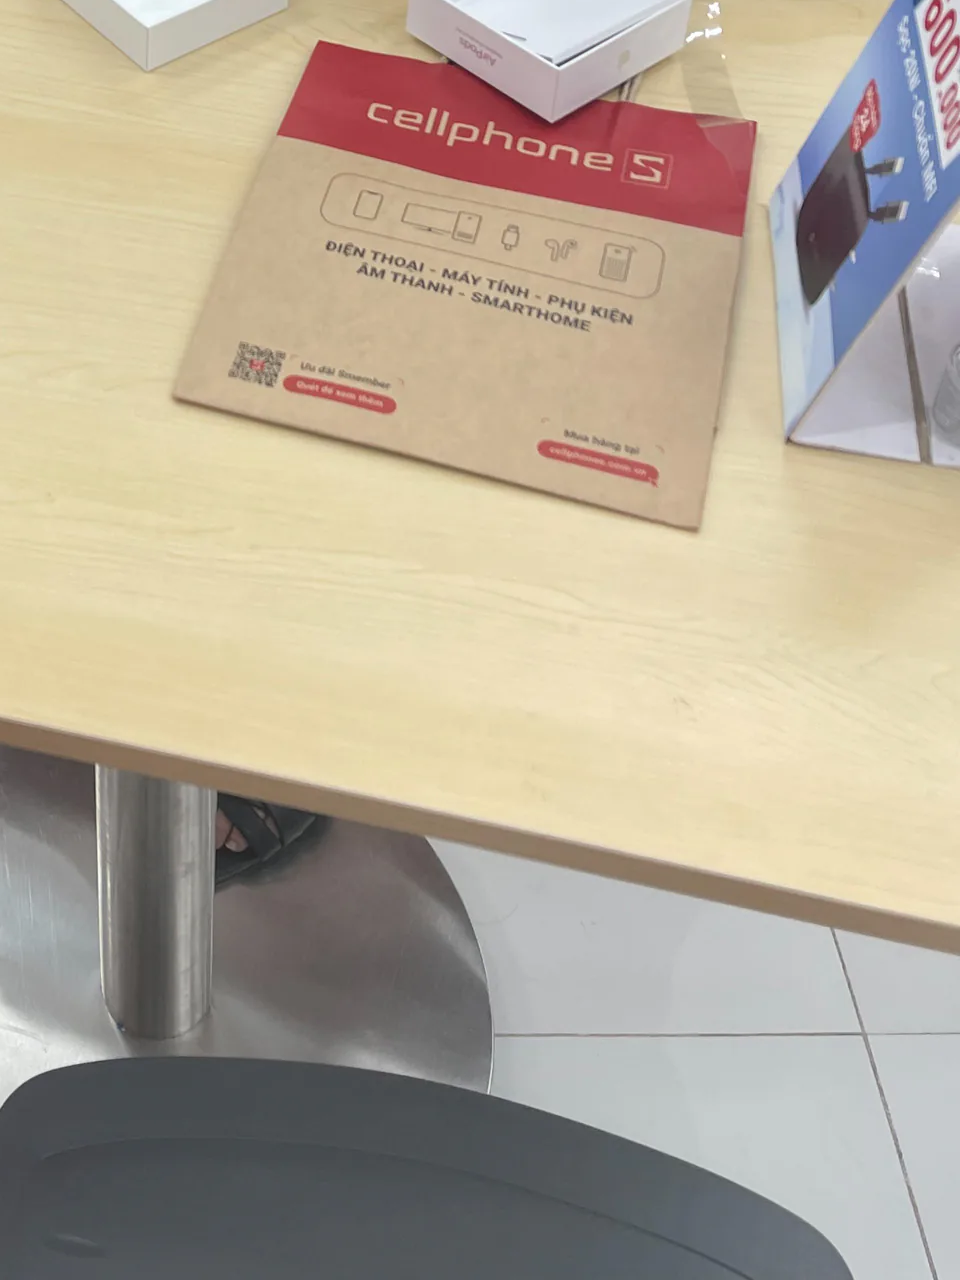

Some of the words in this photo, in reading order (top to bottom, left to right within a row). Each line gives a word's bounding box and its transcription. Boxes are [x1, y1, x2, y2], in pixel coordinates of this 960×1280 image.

[325, 240, 366, 259] ĐIỆN
[370, 249, 425, 273] THOẠI
[441, 268, 482, 287] MÁY
[486, 277, 530, 299] TÍNH
[546, 294, 587, 315] PHỤ
[590, 305, 635, 326] KIỆN
[356, 262, 386, 280] ÂM
[390, 270, 454, 297] THANH
[471, 291, 592, 332] SMARTHOME
